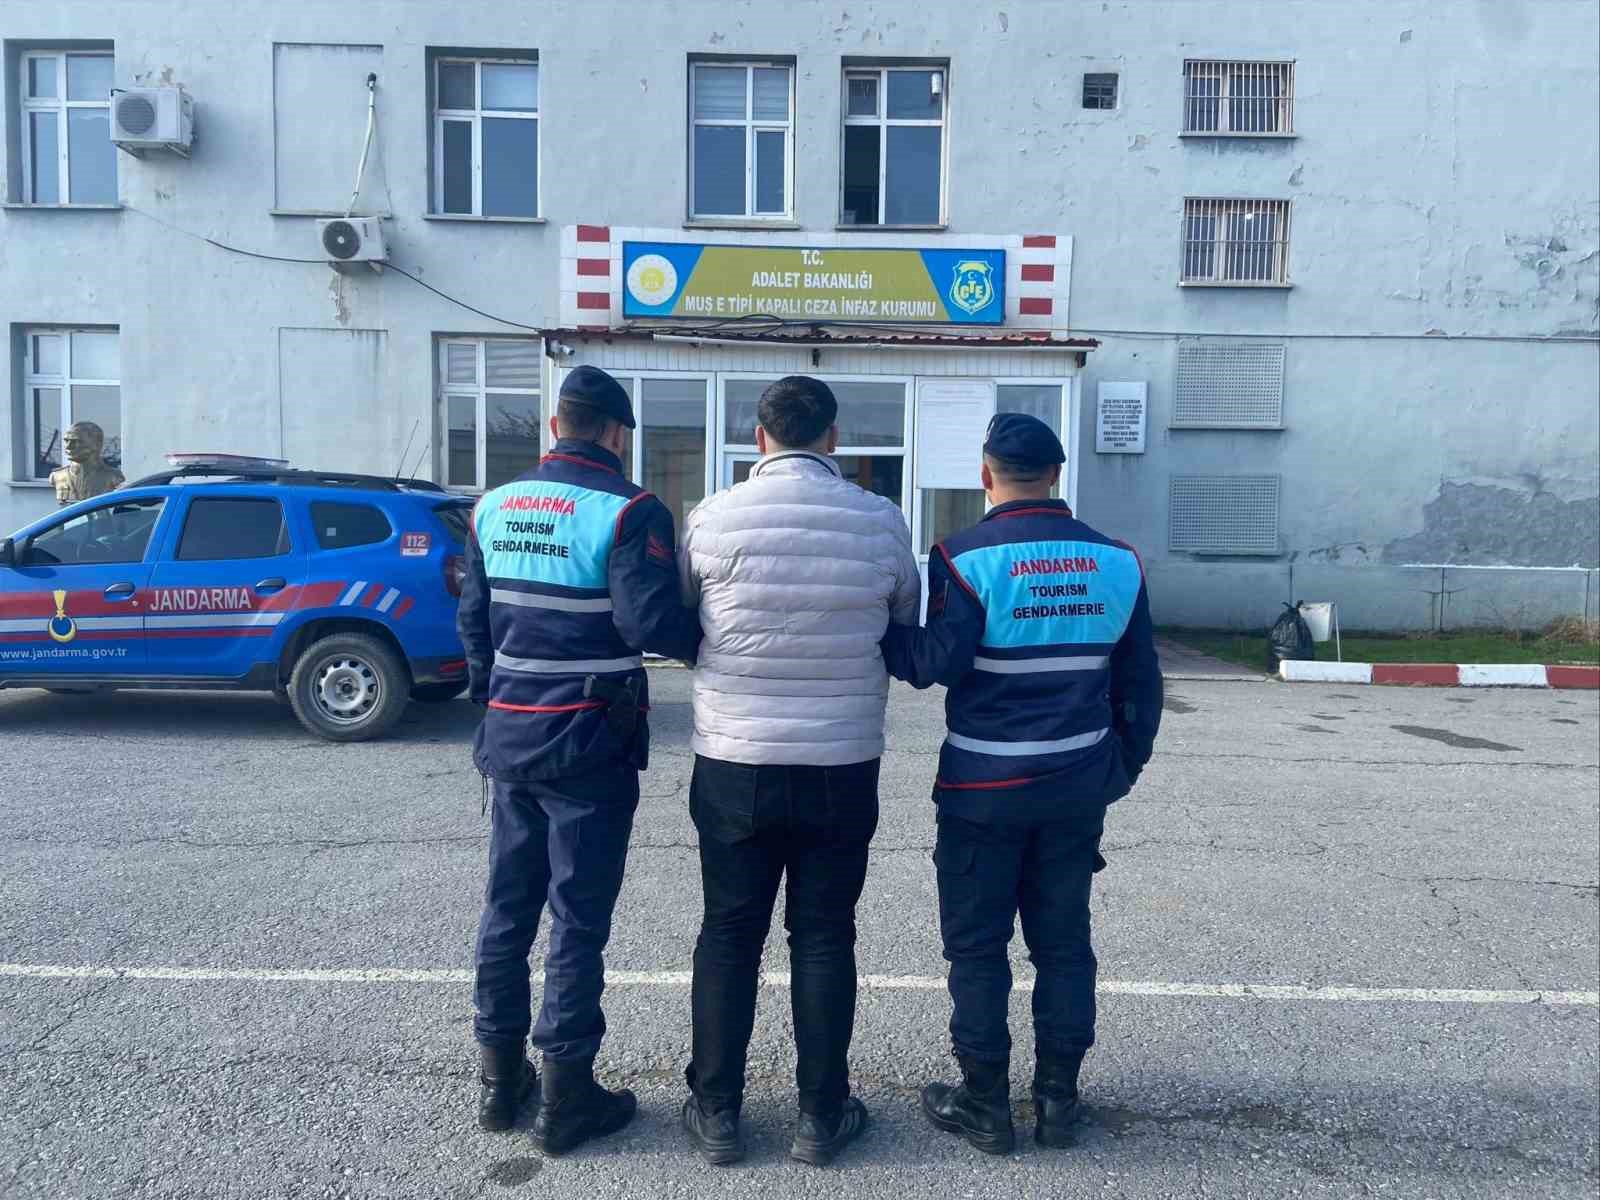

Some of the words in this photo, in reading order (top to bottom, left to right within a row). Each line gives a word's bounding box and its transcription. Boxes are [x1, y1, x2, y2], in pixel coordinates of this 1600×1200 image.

[800, 249, 824, 265] T.C.
[751, 271, 801, 288] ADALET
[804, 270, 873, 289] BAKANLIĞI
[684, 295, 713, 316] MUŞ
[717, 297, 725, 312] E
[728, 293, 752, 312] TİPİ
[756, 298, 801, 314] KAPALI
[804, 299, 838, 315] CEZA
[841, 296, 878, 316] İNFAZ
[880, 300, 937, 317] KURUMU
[499, 495, 576, 515] JANDARMA
[505, 521, 555, 536] TOURISM
[405, 535, 428, 547] 112
[492, 540, 569, 558] GENDARMERIE
[1010, 557, 1098, 577] JANDARMA
[1029, 583, 1088, 598] TOURISM
[150, 588, 252, 611] JANDARMA
[1013, 602, 1105, 619] GENDARMERIE
[0, 647, 128, 660] www.jandarma.gov.tr
